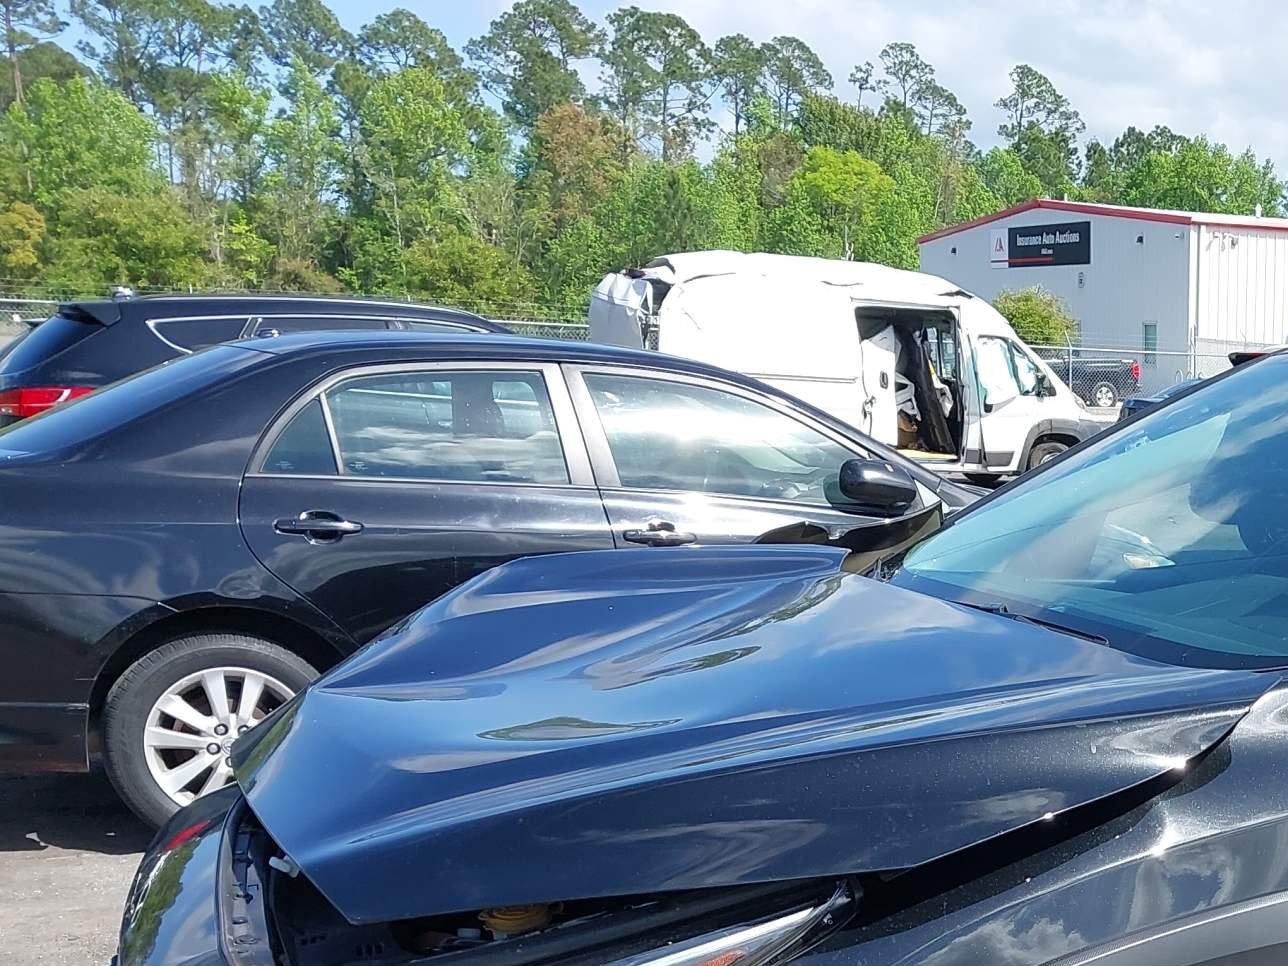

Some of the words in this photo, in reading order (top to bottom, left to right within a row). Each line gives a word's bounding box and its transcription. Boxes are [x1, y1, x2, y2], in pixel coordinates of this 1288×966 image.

[1016, 234, 1041, 246] Insurance
[1042, 231, 1054, 245] Auto
[1055, 230, 1080, 244] Auctions
